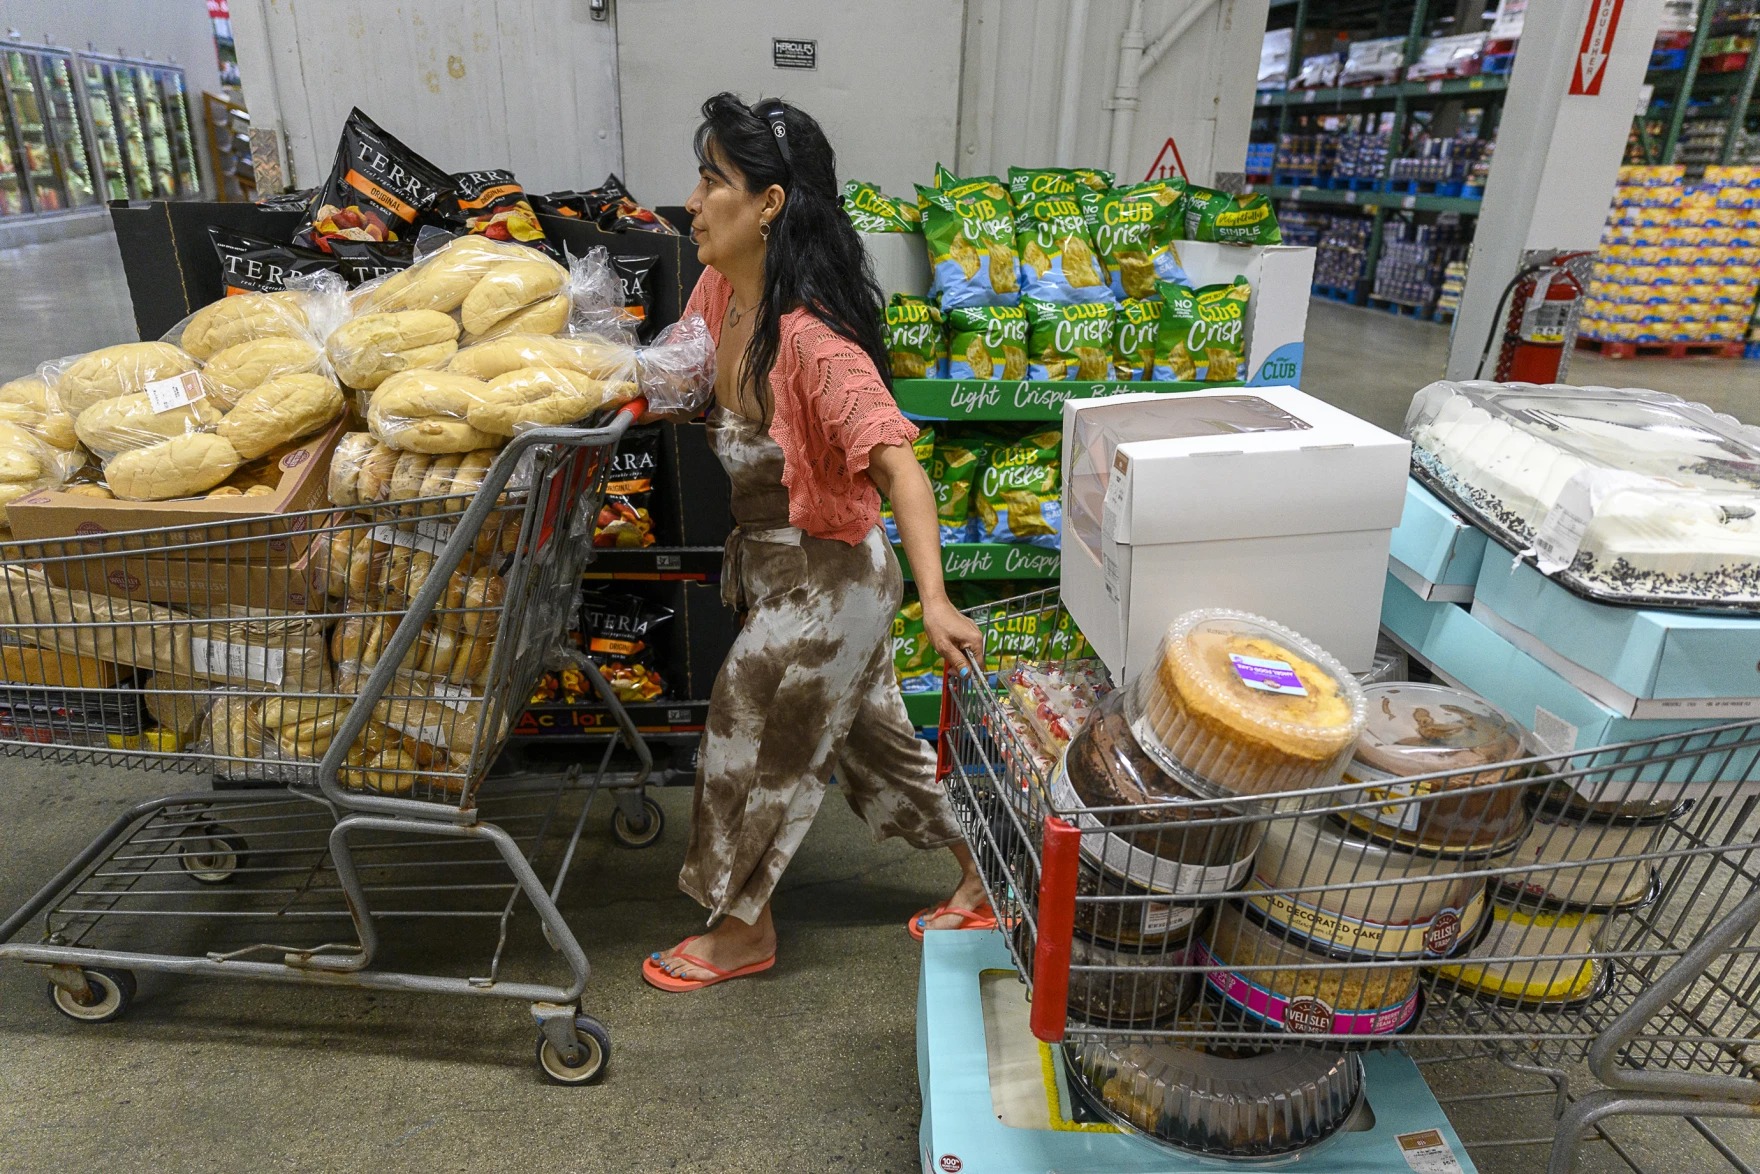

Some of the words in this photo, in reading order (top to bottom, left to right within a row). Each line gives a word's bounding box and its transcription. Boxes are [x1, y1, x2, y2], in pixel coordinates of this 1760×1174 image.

[357, 141, 438, 209] TERRA
[458, 171, 511, 195] ERR
[370, 187, 401, 212] ORIGINAL
[855, 189, 897, 217] CLUB
[1034, 201, 1081, 221] CLUB
[1083, 205, 1099, 214] NO
[1104, 201, 1154, 226] CLUB
[1038, 216, 1089, 249] Crisp
[1219, 226, 1261, 237] SIMPLE
[225, 254, 303, 285] TERR
[885, 305, 930, 325] CLUB
[1063, 303, 1108, 321] CLUB
[1174, 299, 1193, 309] NO
[1198, 303, 1242, 322] CLUB
[1055, 319, 1114, 353] Crisps
[1188, 320, 1243, 351] Crisp
[1262, 361, 1297, 381] CLUB
[950, 383, 1002, 413] Light
[1014, 381, 1077, 415] Crispy
[992, 447, 1039, 469] CLUB
[983, 465, 1046, 498] Crisps
[945, 550, 994, 578] Light
[1006, 548, 1061, 576] Crispy
[994, 611, 1037, 634] CLUB
[1262, 894, 1285, 909] OLD
[1286, 904, 1351, 933] DECORATED
